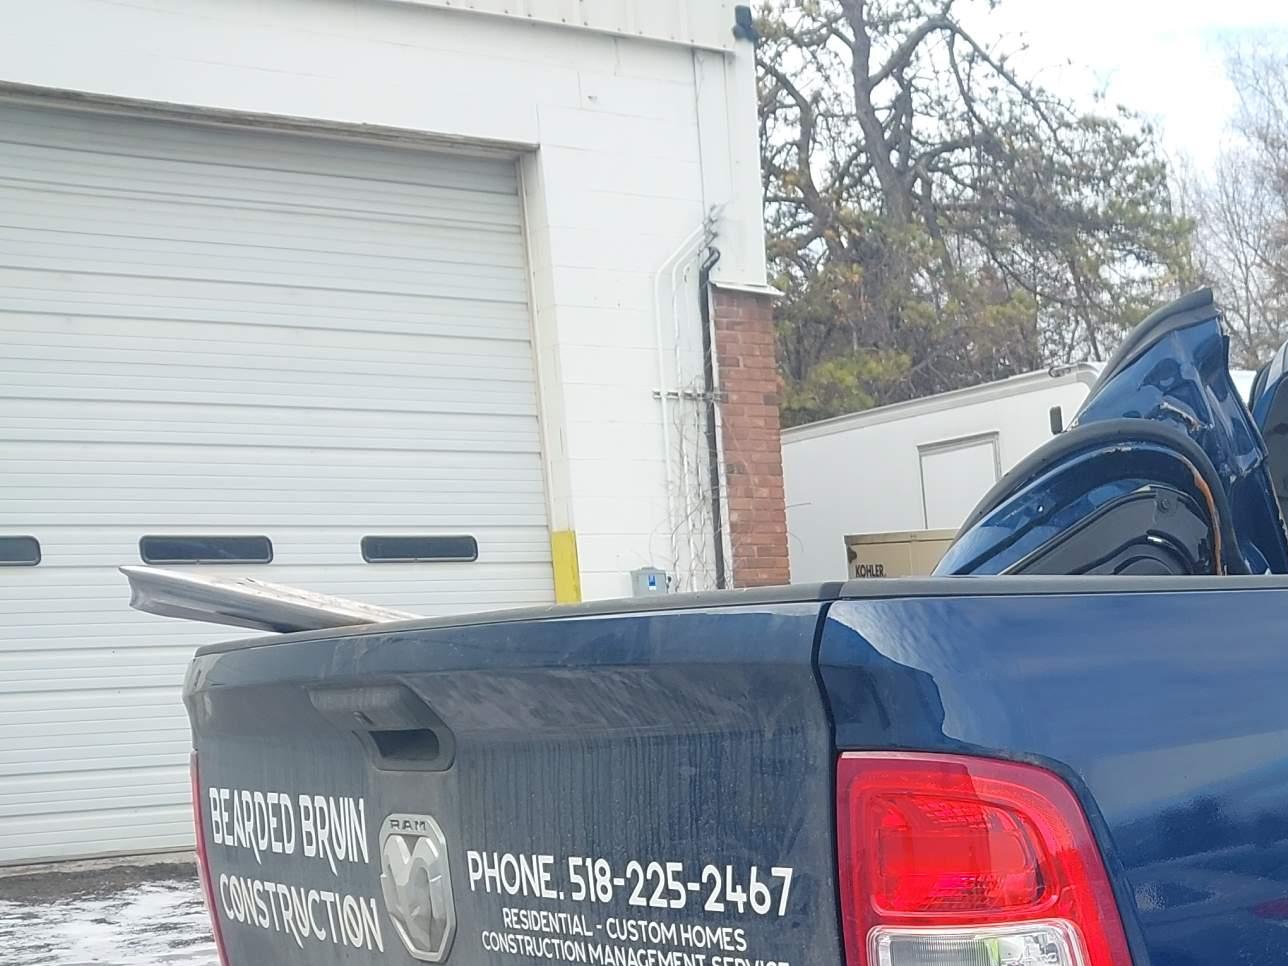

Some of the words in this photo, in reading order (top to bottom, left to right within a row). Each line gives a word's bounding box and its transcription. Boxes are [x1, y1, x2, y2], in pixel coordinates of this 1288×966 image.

[209, 787, 295, 864] BEARDED
[299, 795, 369, 876] BRUIN
[390, 819, 426, 830] RAM
[467, 850, 565, 900] PHONE.
[568, 856, 793, 916] 518-225-2467
[219, 873, 384, 952] CONSTRUCTION
[502, 907, 594, 937] RESIDENTIAL
[606, 917, 678, 946] CUSTOM
[681, 924, 747, 951] HOMES
[481, 931, 586, 963] CONSTRUCTION
